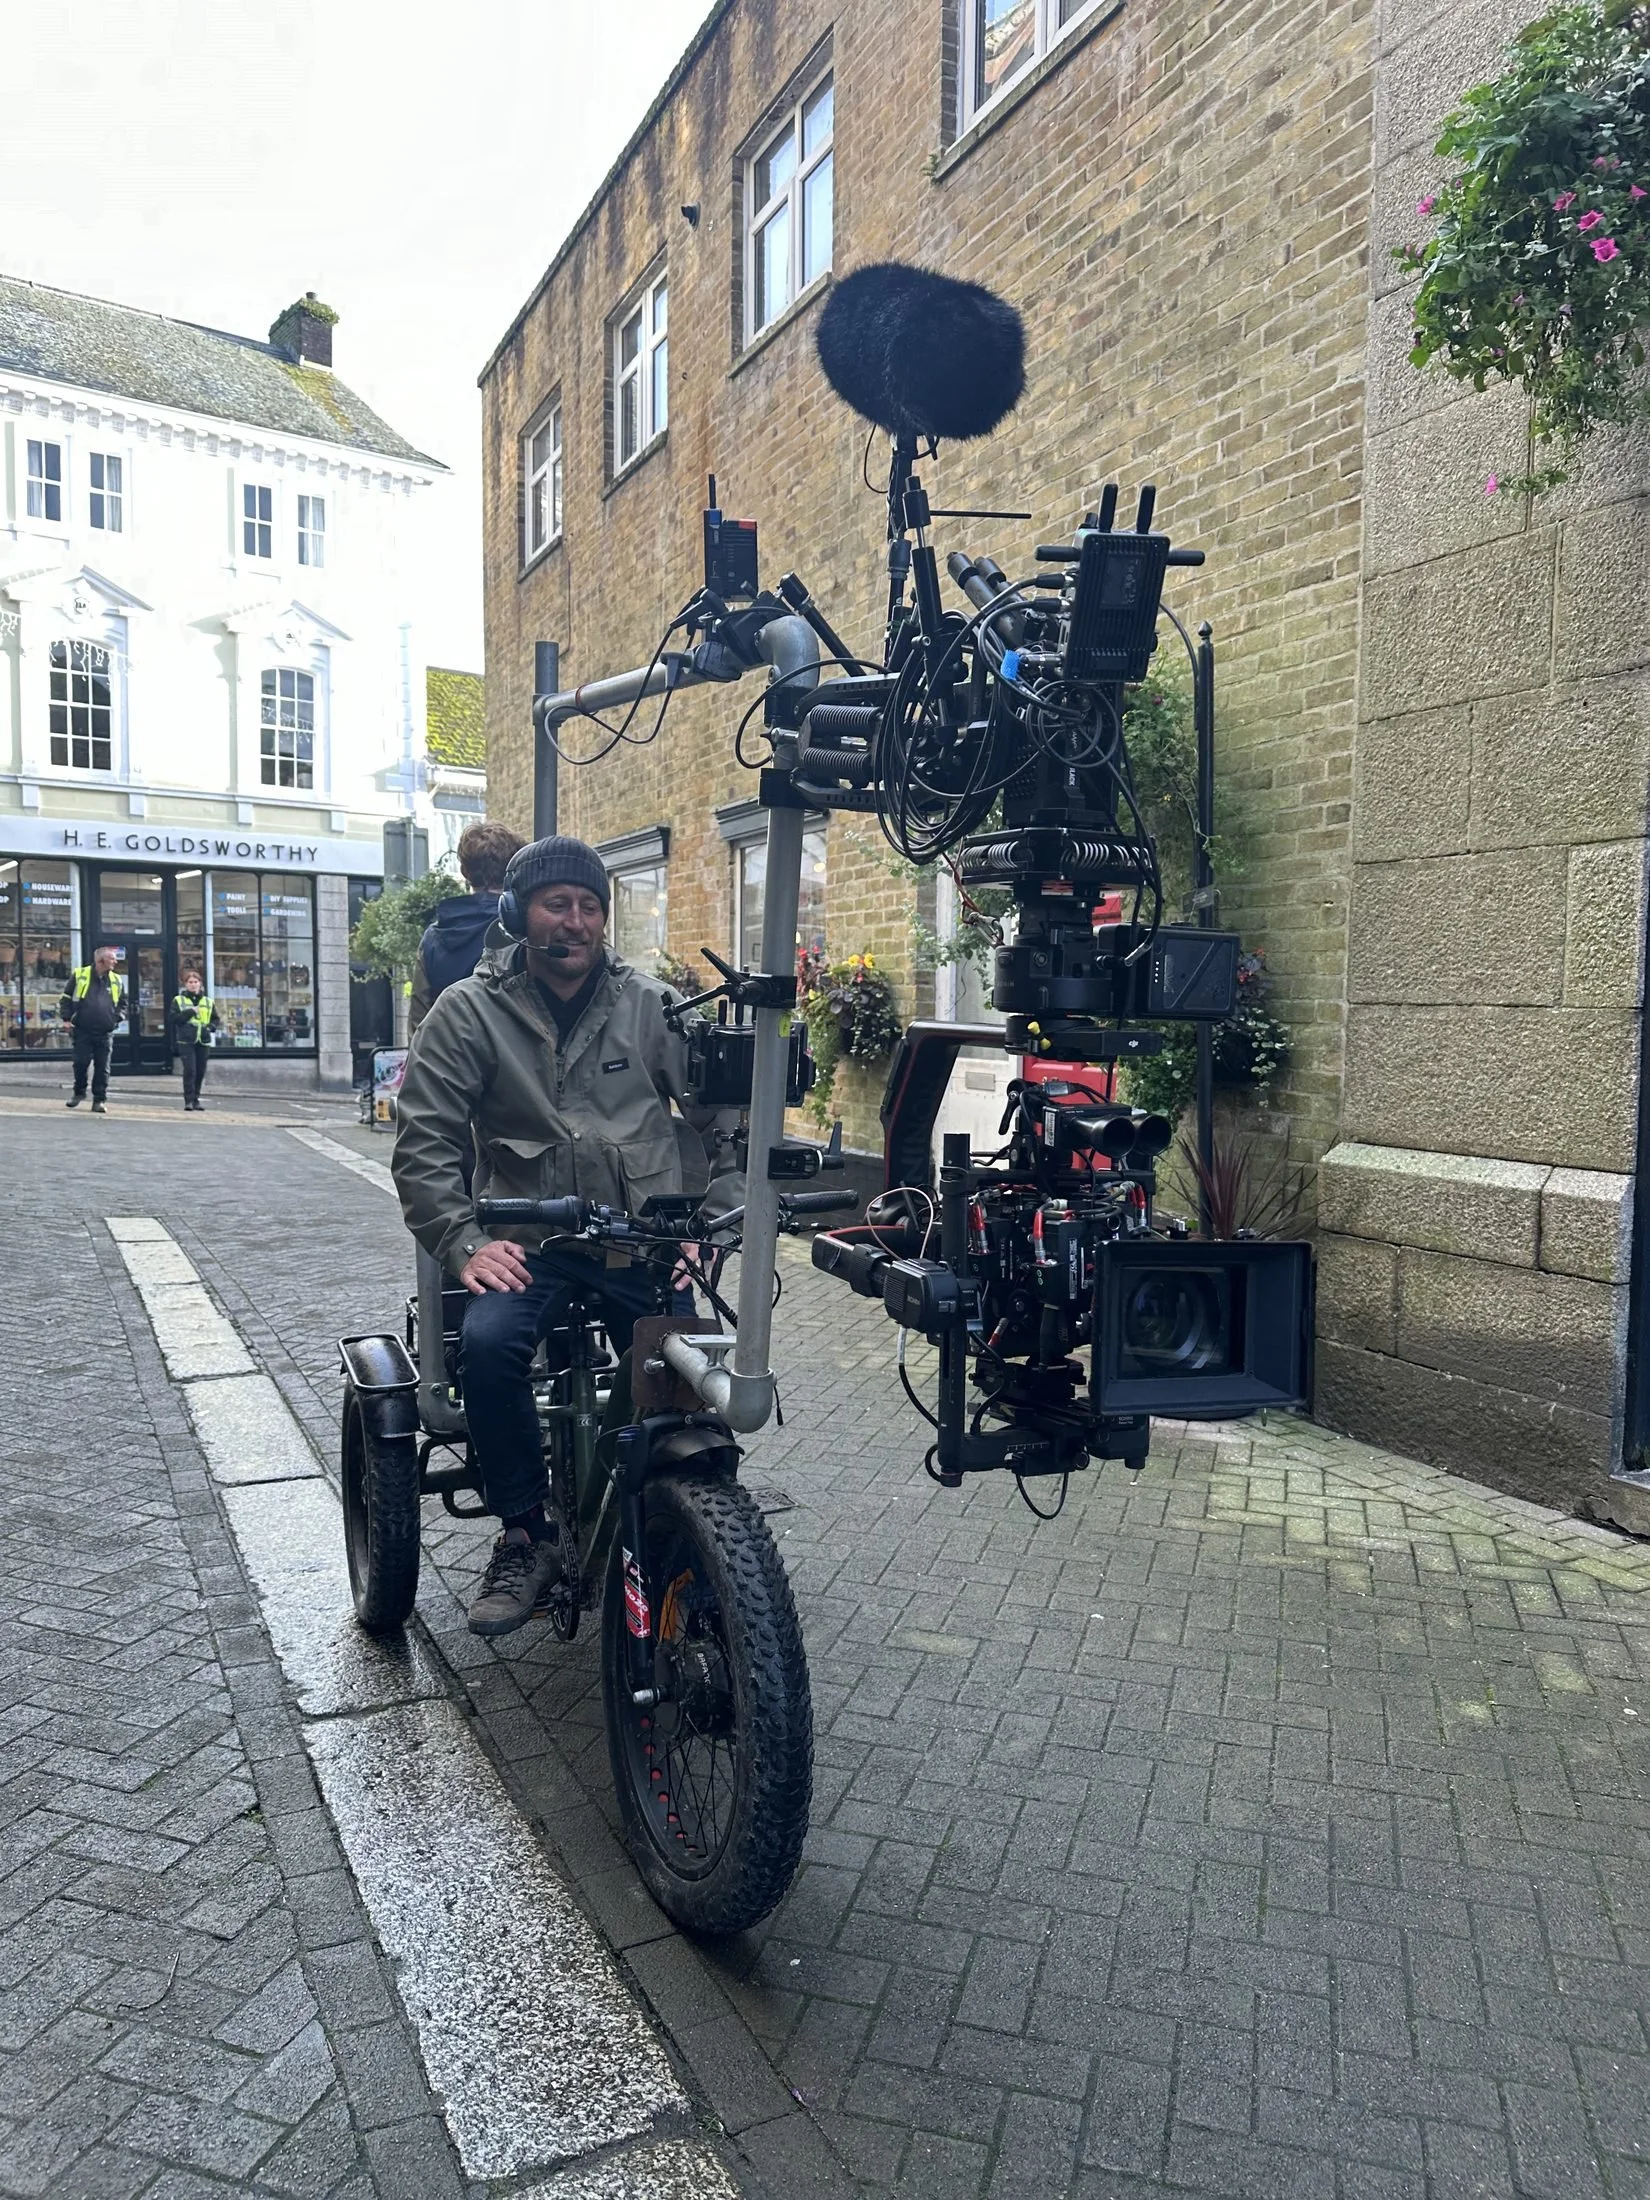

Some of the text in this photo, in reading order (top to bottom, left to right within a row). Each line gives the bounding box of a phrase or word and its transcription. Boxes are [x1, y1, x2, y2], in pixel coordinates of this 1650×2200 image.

[63, 829, 318, 862] H. E. GOLDSWORTHY
